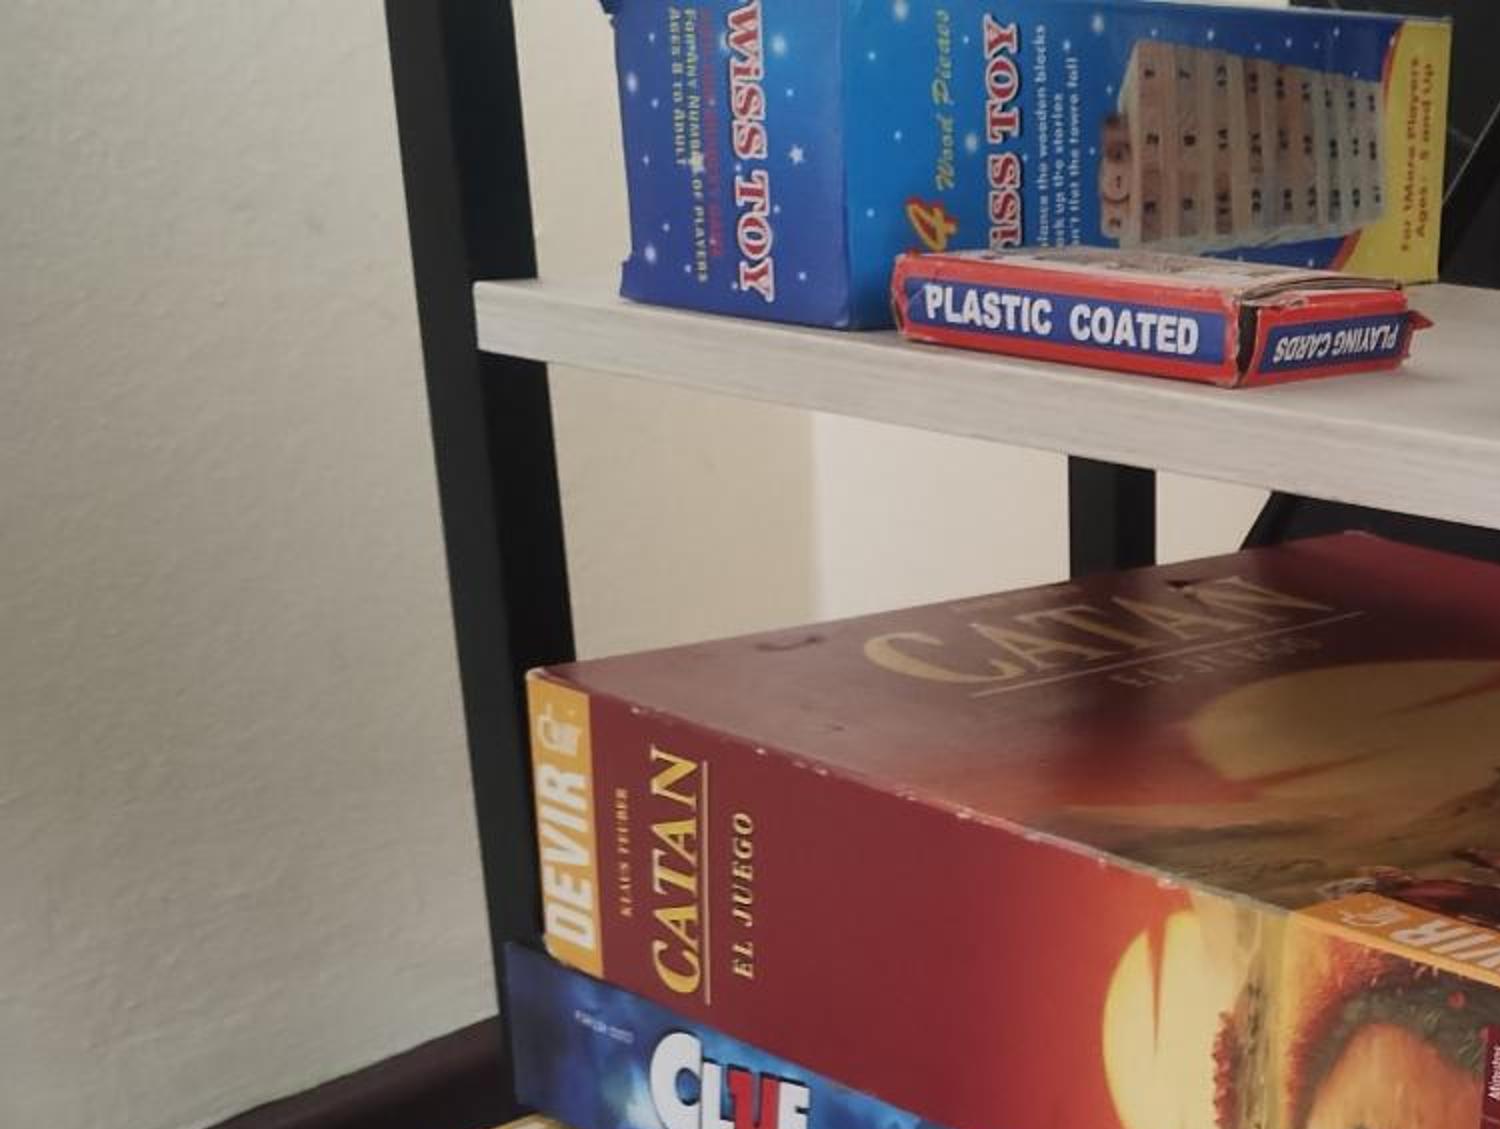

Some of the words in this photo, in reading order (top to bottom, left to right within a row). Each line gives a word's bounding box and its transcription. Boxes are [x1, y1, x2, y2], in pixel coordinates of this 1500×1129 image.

[982, 13, 1021, 144] TOY
[1032, 24, 1048, 84] blocks
[1034, 87, 1049, 159] wooden
[735, 169, 775, 304] TOY
[907, 196, 958, 250] 4
[923, 283, 1054, 337] PLASTIC
[1068, 306, 1201, 356] COATED
[1273, 331, 1333, 363] CARDS
[1332, 322, 1400, 355] PLAYING
[863, 574, 1335, 686] CATAN
[533, 764, 597, 952] DEVIR
[649, 744, 703, 993] CATAN
[730, 812, 755, 928] JUEGO
[732, 937, 755, 980] EL
